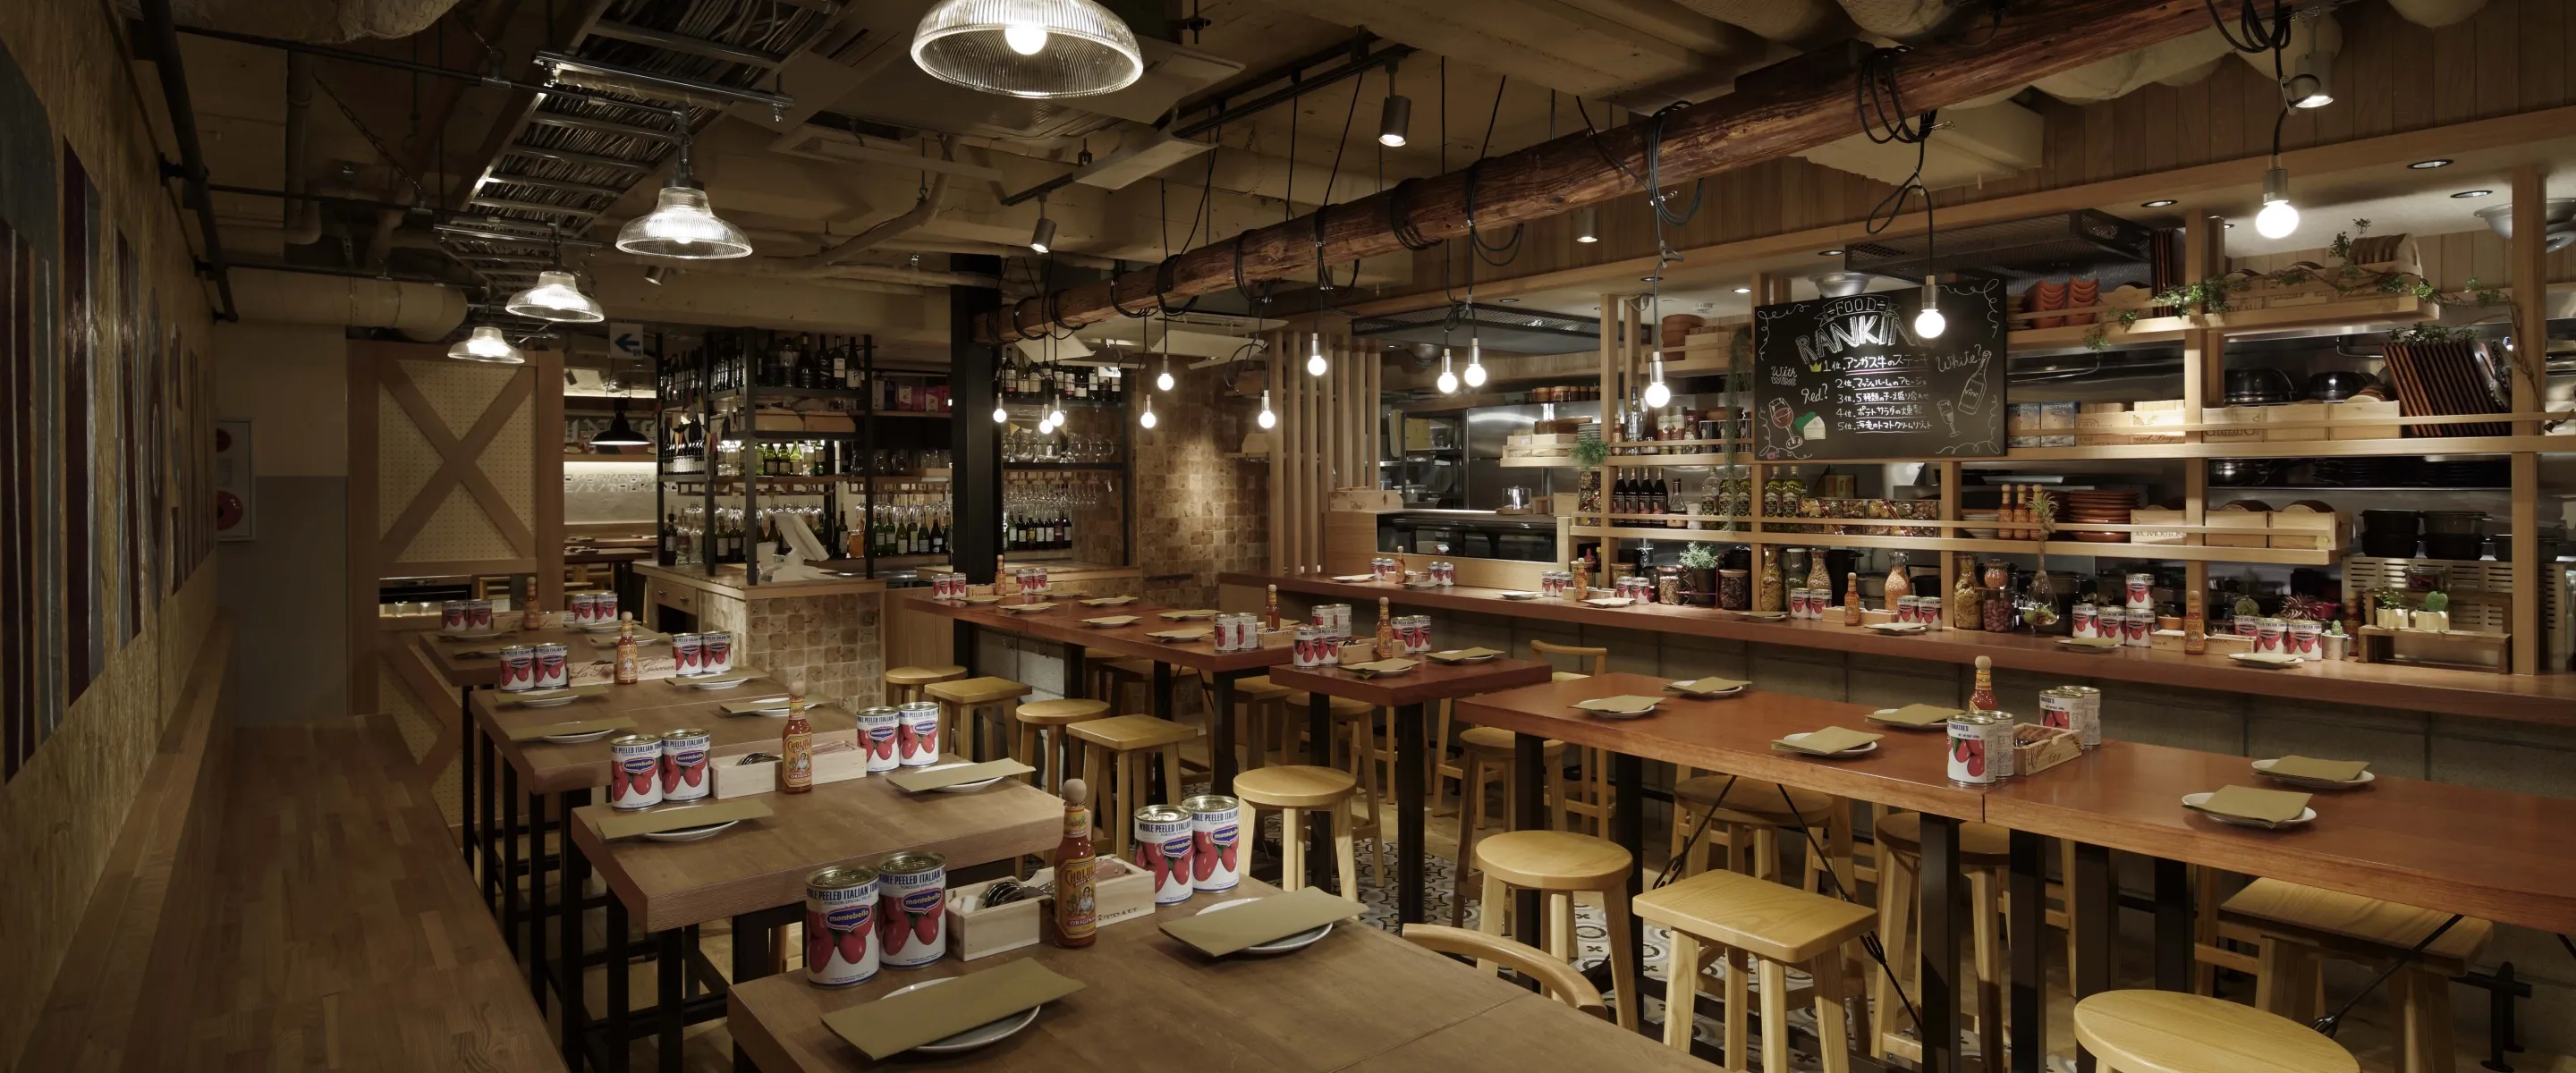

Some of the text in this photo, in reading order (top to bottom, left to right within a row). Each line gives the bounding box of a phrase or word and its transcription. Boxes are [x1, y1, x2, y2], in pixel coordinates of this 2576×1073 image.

[1835, 297, 1877, 313] FOOD
[1795, 315, 1932, 365] RANKIN
[1936, 343, 1981, 373] White?
[1771, 366, 1797, 377] With
[1801, 383, 1828, 404] Red?
[635, 745, 654, 754] ITALIAN
[686, 739, 703, 747] ITALIAN
[678, 753, 704, 761] montebello
[1204, 813, 1224, 822] PEELED
[1139, 823, 1154, 832] WHOLE
[1155, 824, 1174, 833] PEELED
[894, 874, 917, 885] PEELED
[919, 869, 941, 883] ITALIAN
[818, 891, 842, 900] PEELED
[843, 885, 869, 899] ITALIAN
[905, 892, 941, 905] montebello
[829, 909, 869, 922] montebello
